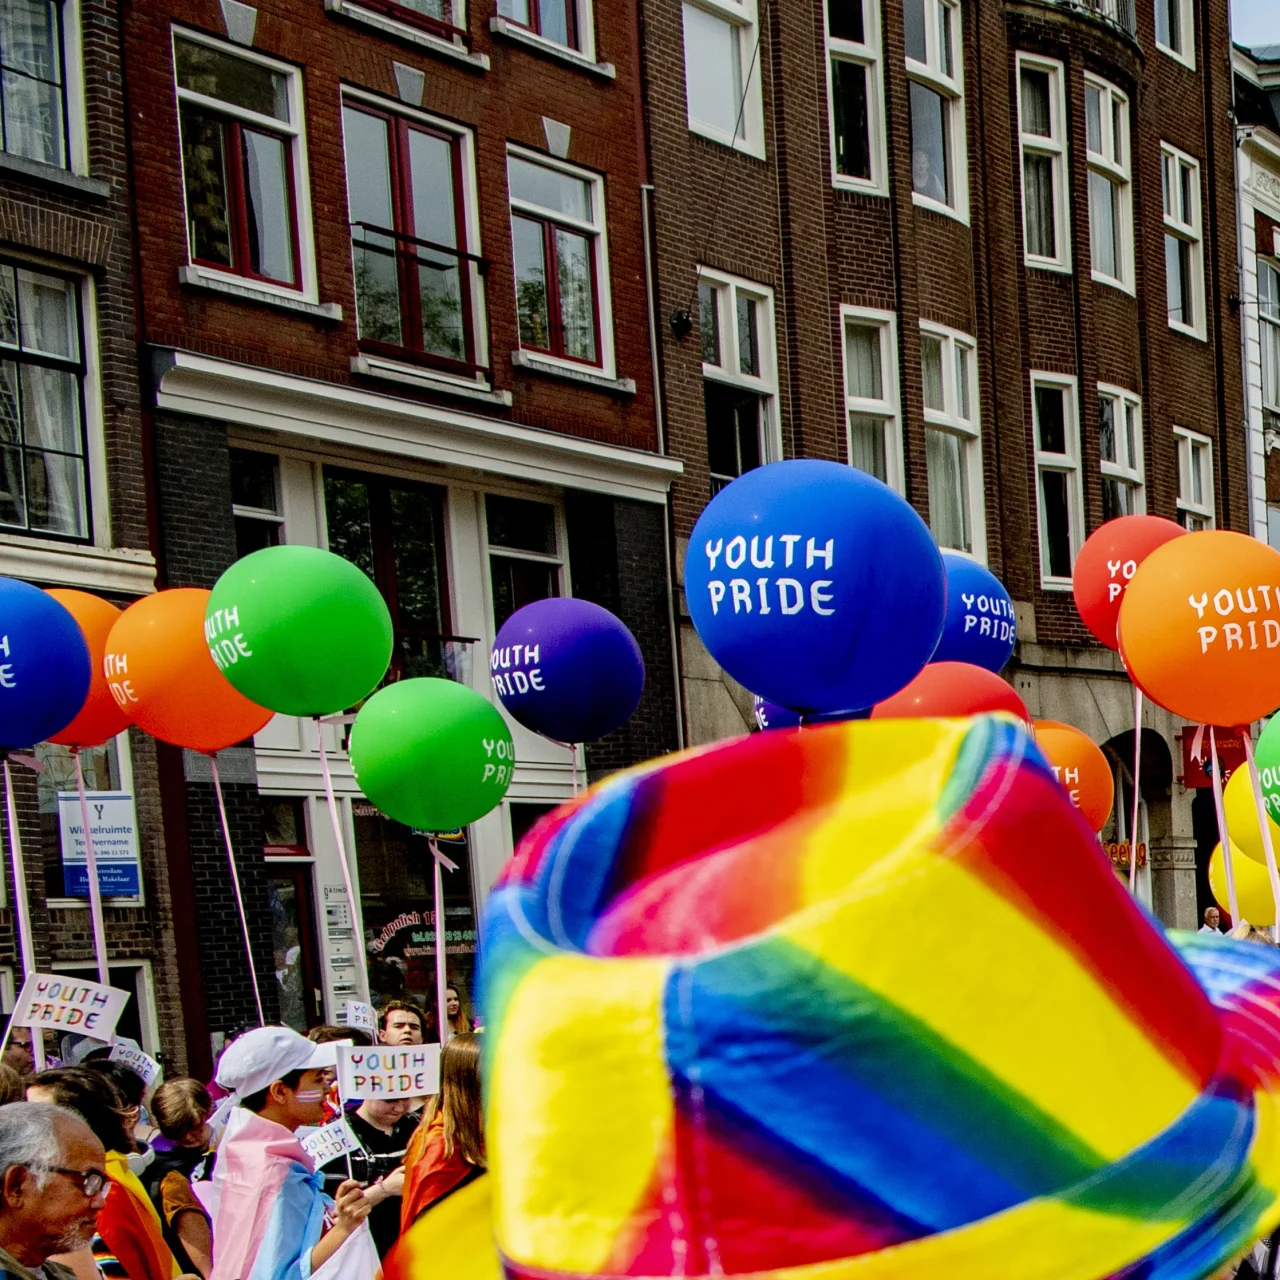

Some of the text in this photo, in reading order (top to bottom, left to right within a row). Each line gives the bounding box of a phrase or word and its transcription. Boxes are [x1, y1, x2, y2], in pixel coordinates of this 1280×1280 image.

[705, 534, 835, 572] YOUTH
[707, 578, 836, 616] PRIDE
[961, 593, 1015, 620] YOUTH
[205, 605, 240, 643] OUTH
[963, 614, 1015, 644] PRIDE
[211, 633, 253, 672] RIDE
[93, 804, 104, 820] Y
[69, 826, 133, 834] Wikelruimte
[36, 981, 110, 1009] YOUTH
[27, 1003, 102, 1030] PRIDE
[350, 1052, 426, 1071] YOUTH
[352, 1072, 425, 1093] PRIDE
